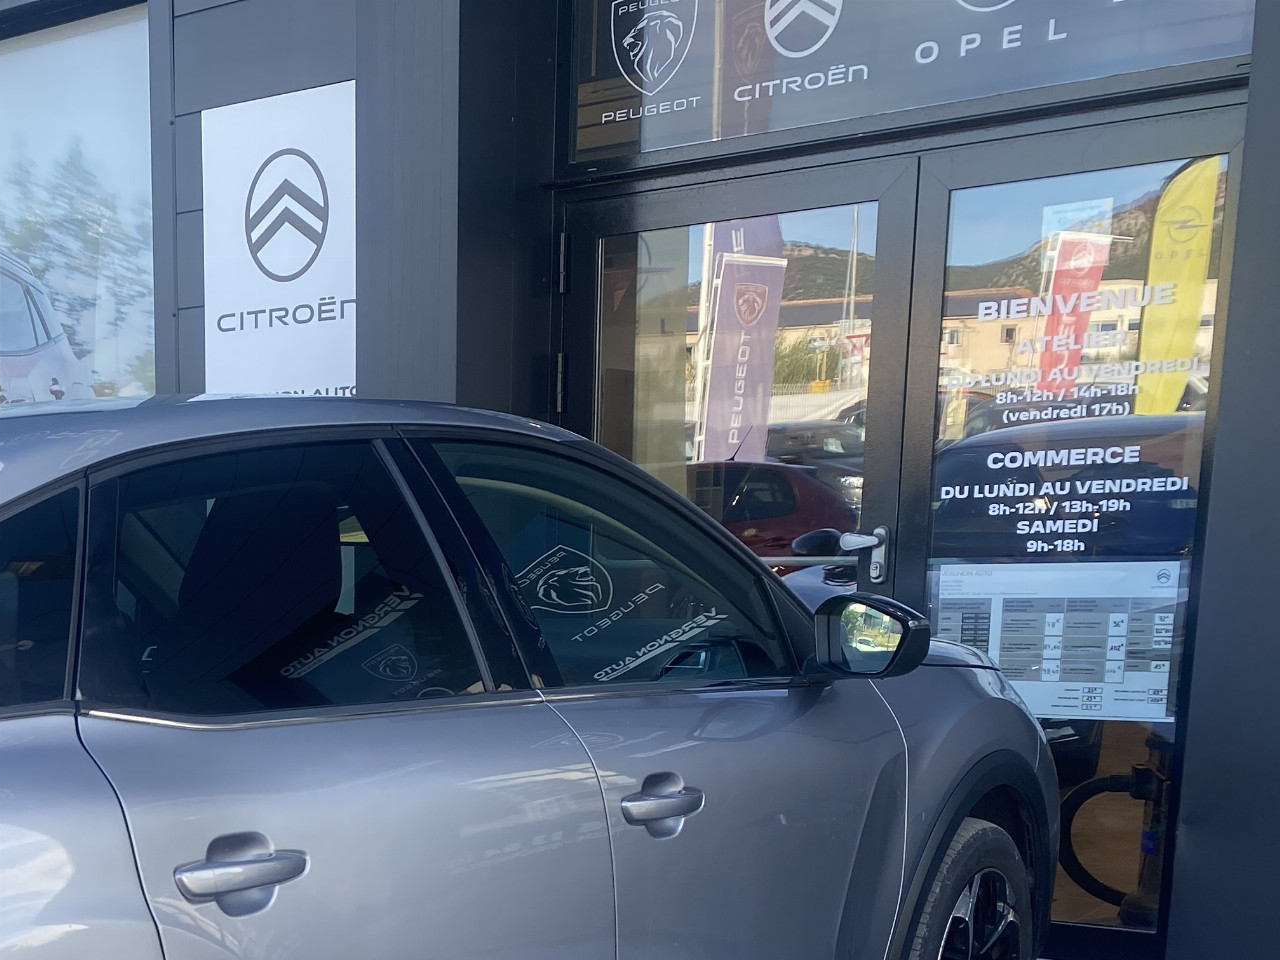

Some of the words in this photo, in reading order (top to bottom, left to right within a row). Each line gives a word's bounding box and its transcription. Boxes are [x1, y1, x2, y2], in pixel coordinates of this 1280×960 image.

[915, 18, 1068, 64] OPEL
[733, 64, 868, 102] CITROËN
[601, 96, 701, 124] PEUGEOT
[978, 283, 1176, 322] BIENVENUE
[1015, 329, 1126, 355] ATELIER
[980, 368, 1042, 387] LUNDI
[1048, 366, 1079, 381] AU
[1083, 357, 1200, 379] VENDREDI
[728, 330, 752, 444] PEUGEOT
[995, 390, 1054, 405] 8h-12h
[1071, 383, 1140, 399] 14h-18h
[1002, 404, 1087, 424] (vendredi
[1091, 401, 1131, 418] 17h)
[986, 445, 1141, 470] COMMERCE
[940, 485, 969, 500] DU
[973, 482, 1035, 498] LUNDI
[1039, 481, 1071, 496] AU
[1075, 476, 1189, 495] VENDREDI
[988, 503, 1046, 516] 8h-12h
[1061, 499, 1131, 514] 13h-19h
[1016, 518, 1099, 534] SAMEDI
[1026, 539, 1085, 552] 9h-18h
